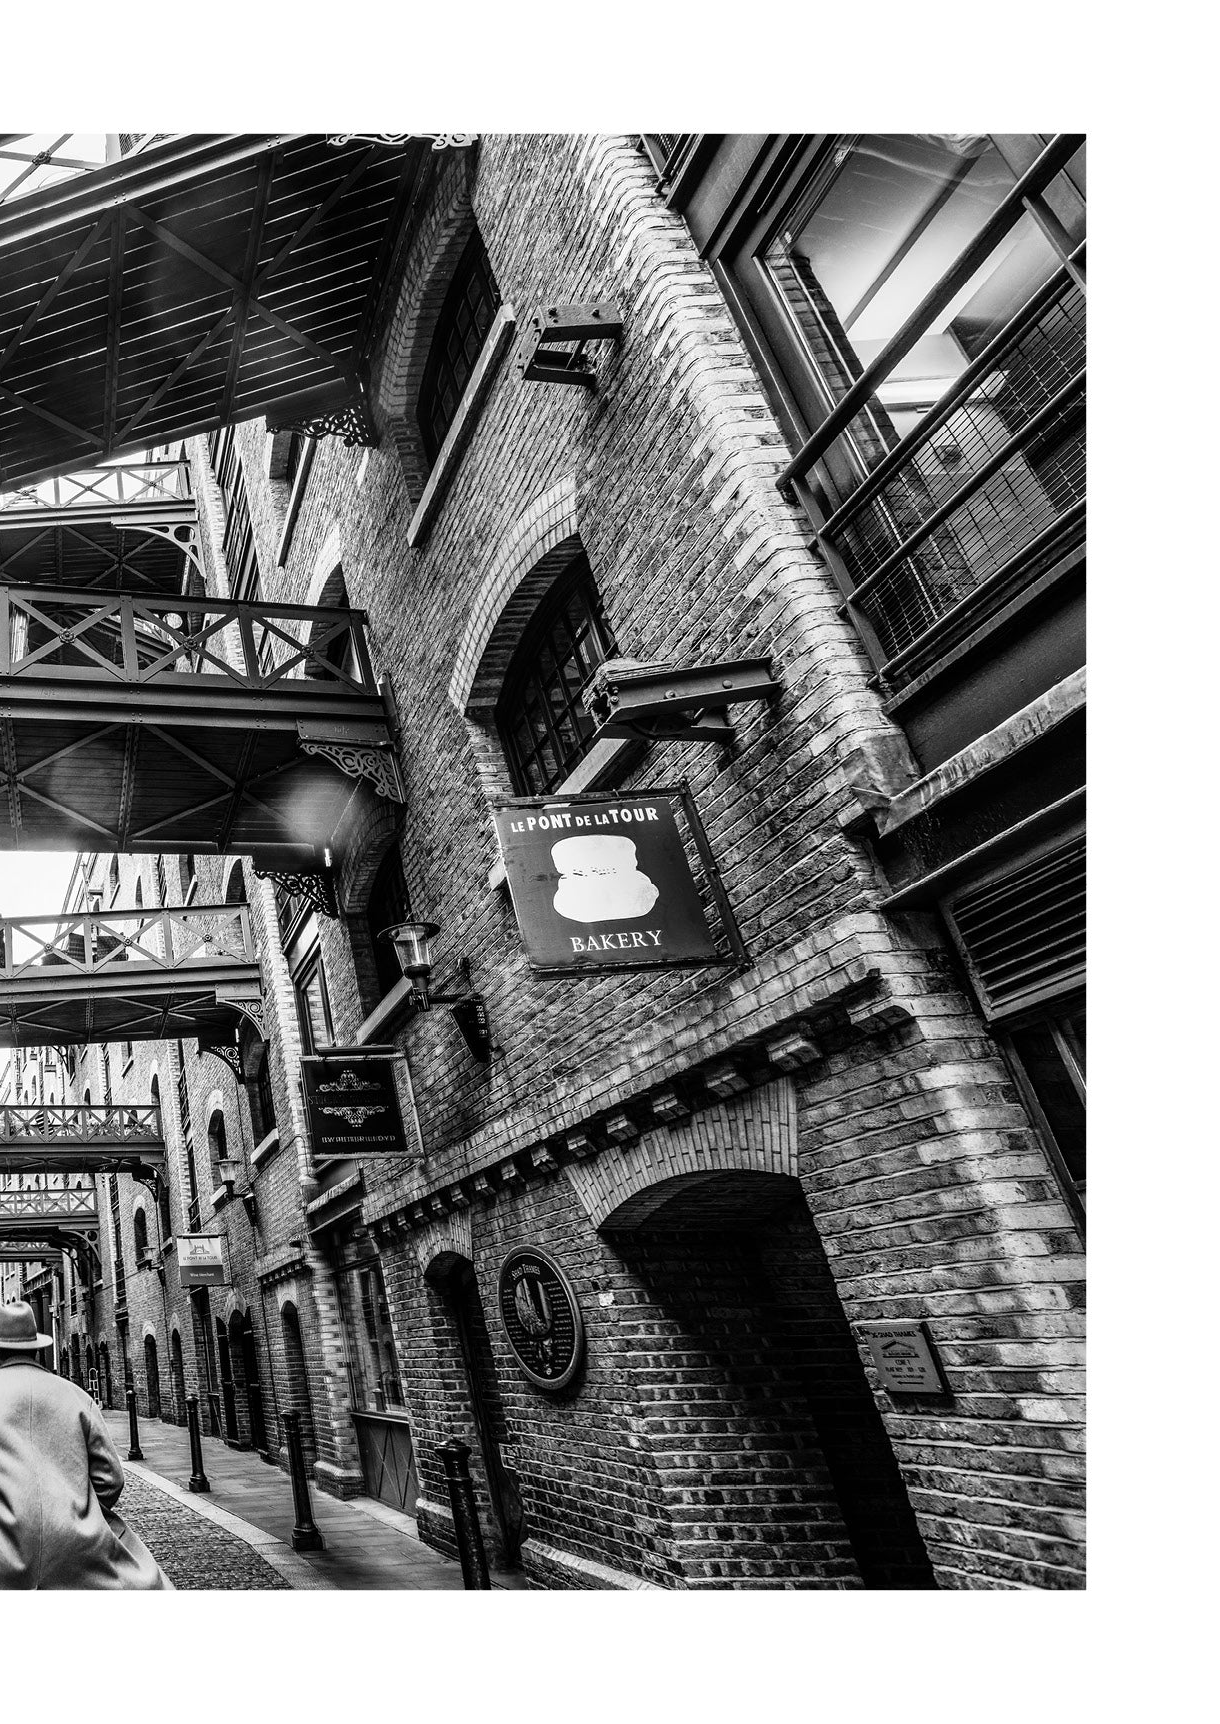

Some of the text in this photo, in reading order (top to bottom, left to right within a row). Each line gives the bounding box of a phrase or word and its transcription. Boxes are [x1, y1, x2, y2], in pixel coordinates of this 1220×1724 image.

[511, 807, 659, 833] LE PONT DE LA TOUR
[570, 930, 662, 953] BAKERY
